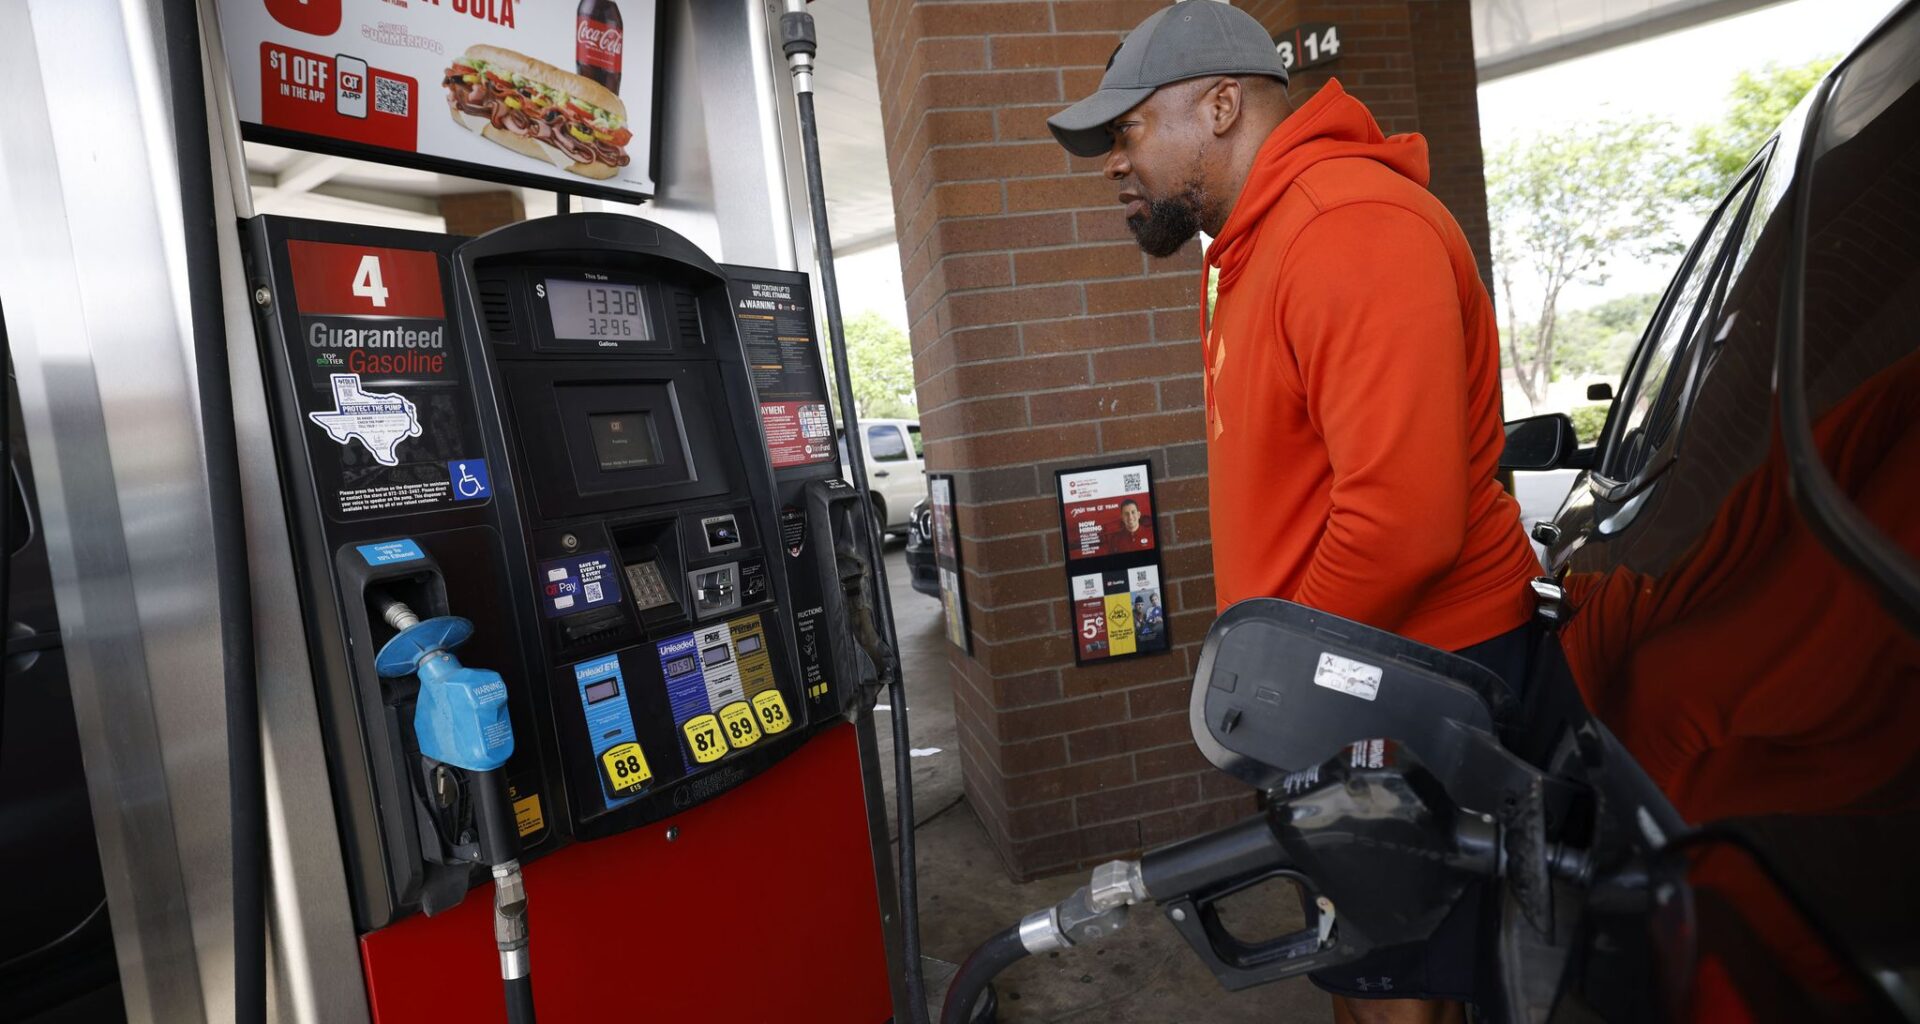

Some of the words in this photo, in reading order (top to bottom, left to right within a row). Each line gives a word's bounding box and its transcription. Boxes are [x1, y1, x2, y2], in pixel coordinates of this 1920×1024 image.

[1304, 26, 1340, 61] 14
[270, 49, 287, 80] $1
[293, 55, 328, 89] OFF
[342, 73, 360, 90] QT
[280, 83, 290, 96] IN
[292, 85, 307, 100] THE
[308, 89, 325, 103] APP
[341, 90, 361, 101] APP
[352, 256, 388, 307] 4
[536, 284, 546, 299] $
[587, 288, 639, 316] 13.38
[745, 300, 775, 310] WARNING
[309, 322, 443, 349] Guaranteed
[589, 319, 632, 336] 3.296
[343, 405, 371, 413] PROTECT
[1078, 520, 1096, 529] NOW
[1079, 525, 1103, 534] HIRING
[559, 582, 576, 593] Pay
[582, 575, 602, 583] GALLON
[730, 620, 760, 634] Premium
[704, 630, 720, 643] Plus
[660, 638, 694, 656] Unleaded
[576, 665, 603, 680] Unlead
[604, 660, 619, 672] E15
[472, 681, 504, 696] WARNING
[762, 703, 784, 724] 93
[729, 717, 752, 739] 89
[695, 729, 716, 752] 87
[615, 755, 640, 778] 88
[629, 783, 642, 793] E15
